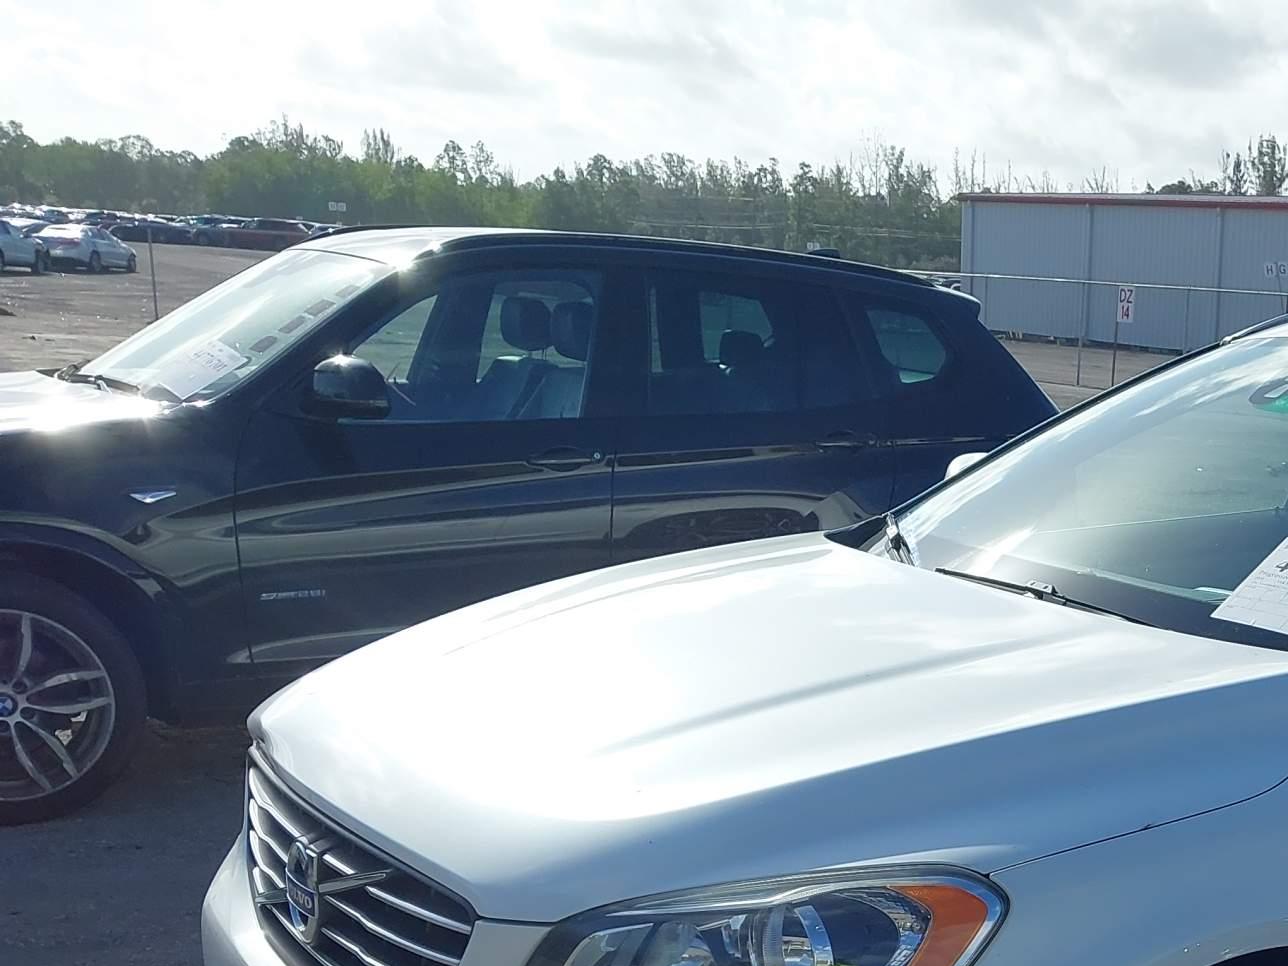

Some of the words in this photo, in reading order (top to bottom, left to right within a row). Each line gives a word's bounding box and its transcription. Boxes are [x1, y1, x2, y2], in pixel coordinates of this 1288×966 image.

[1266, 264, 1274, 276] H
[1280, 263, 1287, 275] G
[1119, 288, 1134, 304] DZ
[1121, 304, 1131, 320] 14
